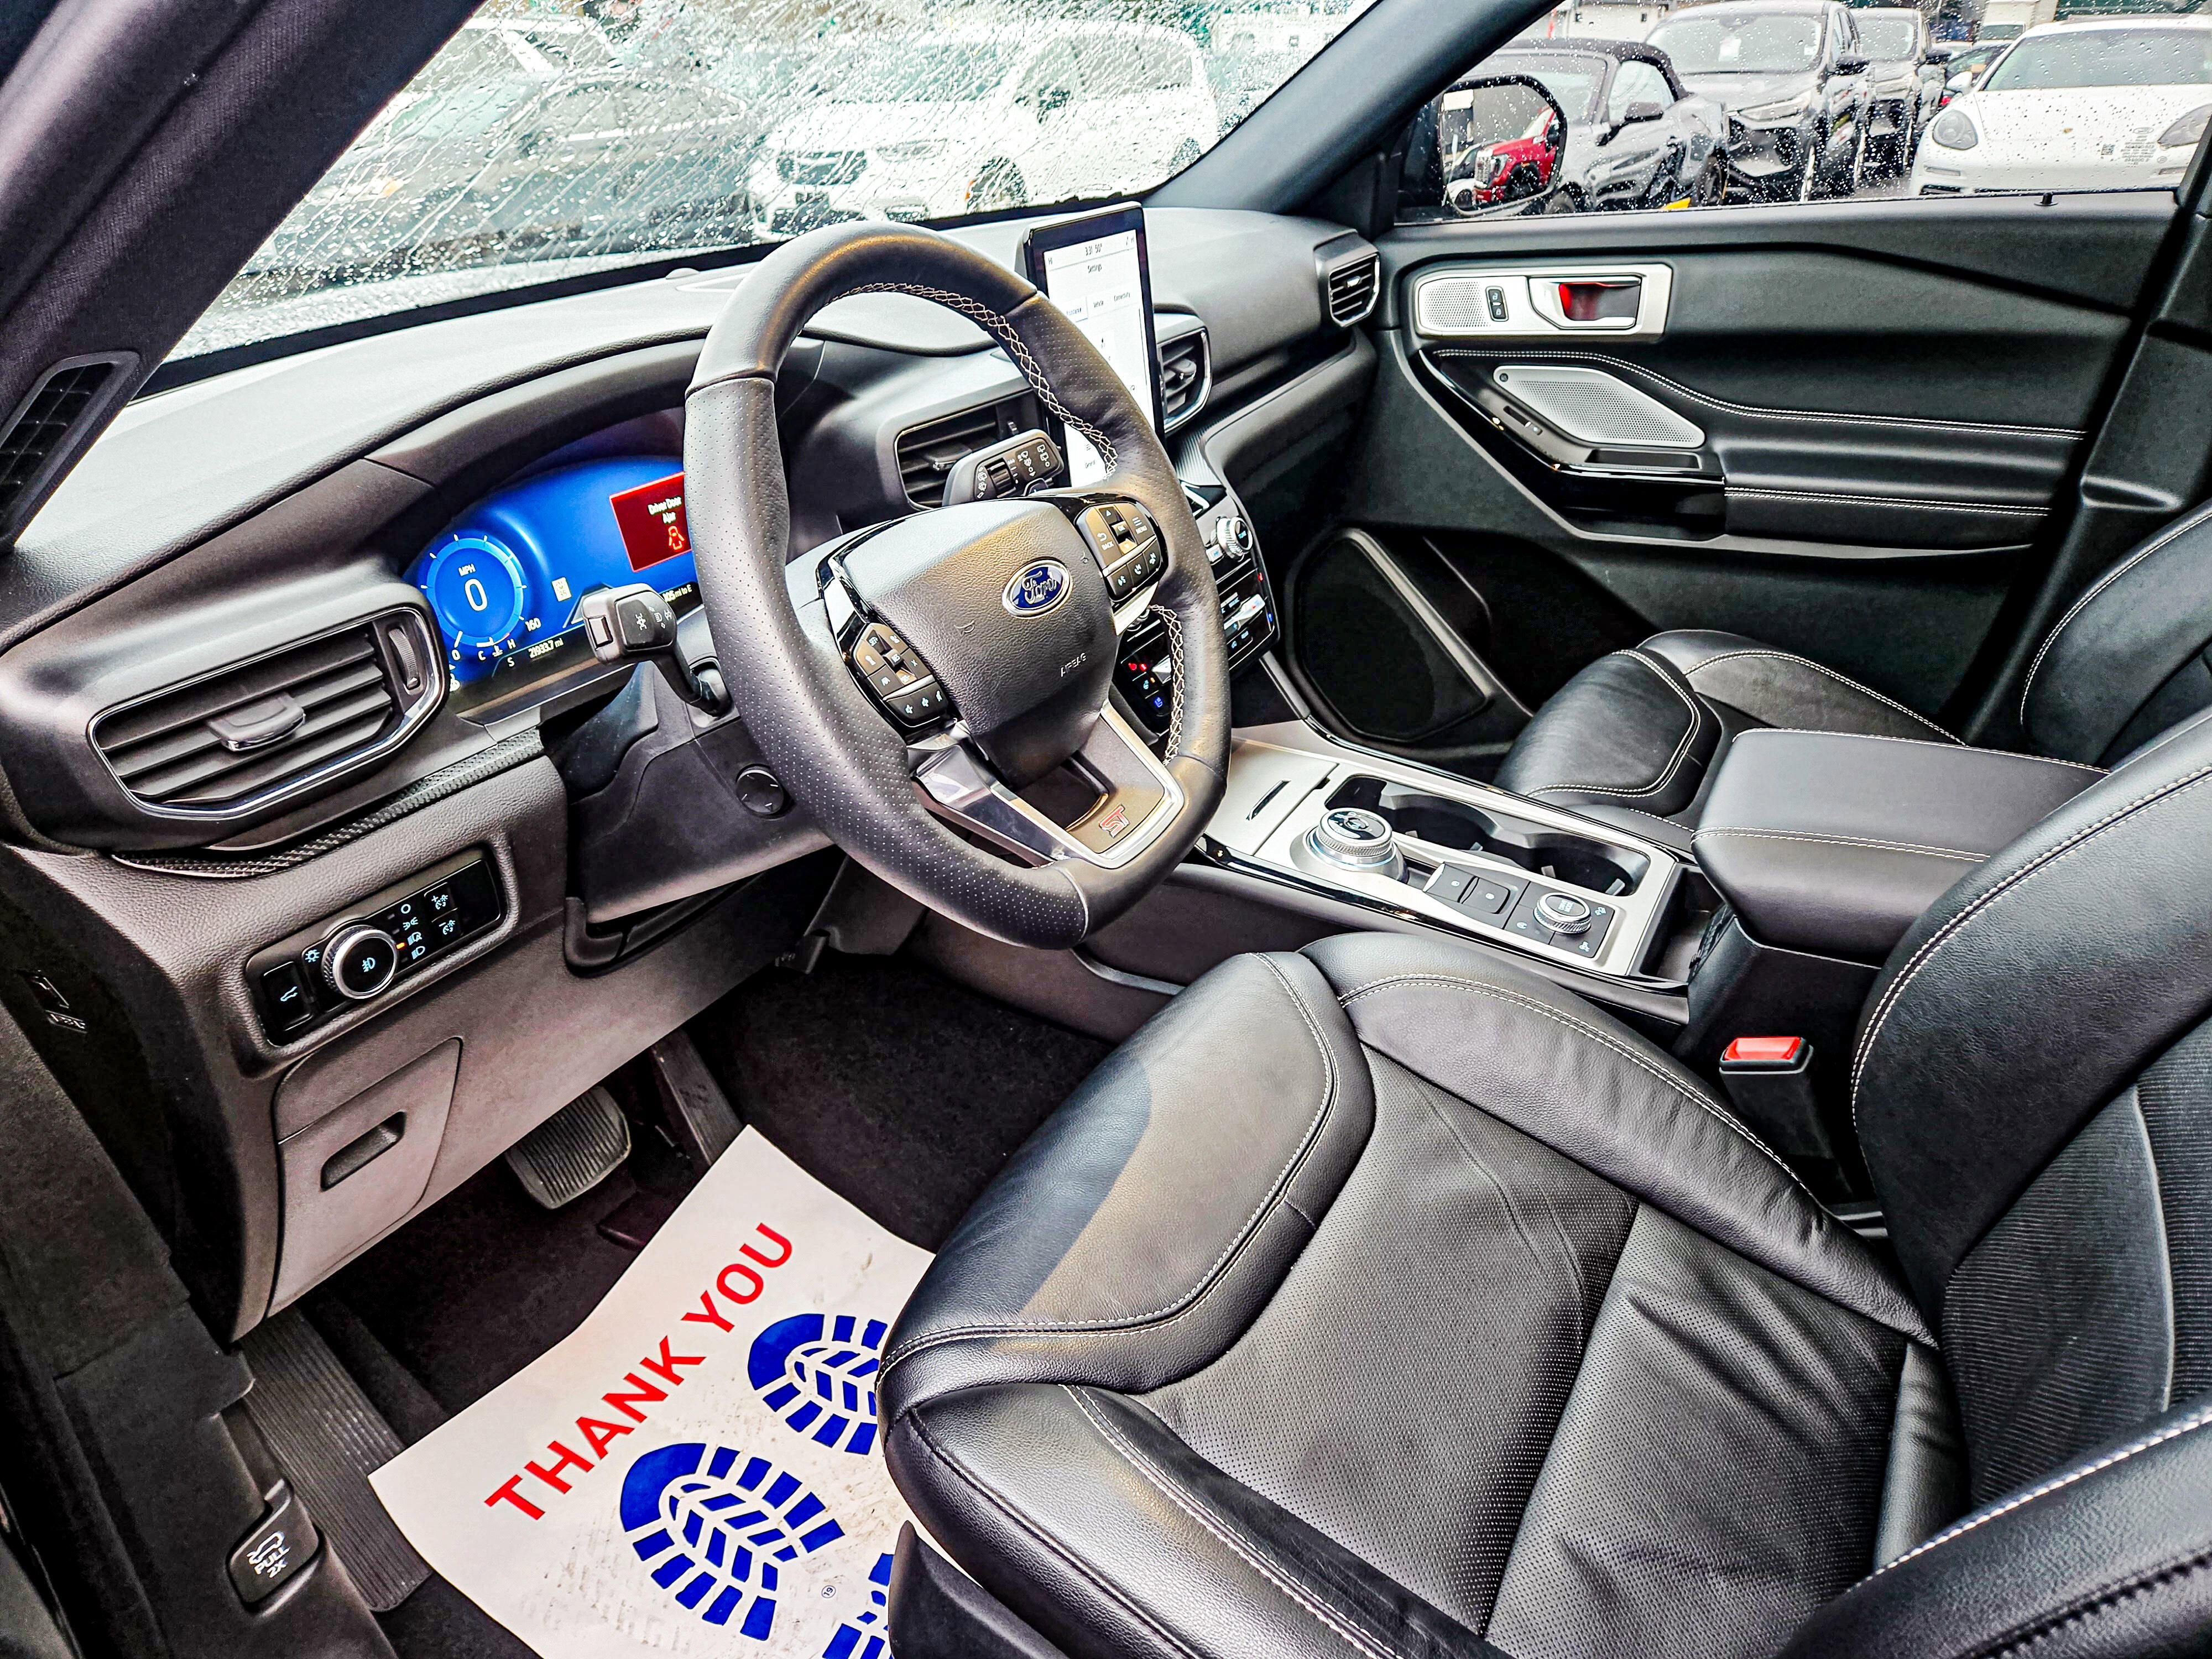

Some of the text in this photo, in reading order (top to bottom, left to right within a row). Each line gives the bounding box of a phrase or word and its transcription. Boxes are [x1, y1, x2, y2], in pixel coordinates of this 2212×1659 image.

[1087, 264, 1102, 274] Settings
[648, 496, 682, 515] Driver Door
[1101, 541, 1114, 551] BACK
[458, 563, 476, 577] MPH
[675, 588, 682, 598] mi
[681, 587, 688, 596] to
[686, 584, 692, 593] E
[1022, 570, 1057, 604] Ford
[465, 578, 488, 612] 0
[525, 618, 541, 632] 160
[507, 638, 517, 649] H
[555, 638, 564, 648] mi
[451, 649, 461, 661] 0
[478, 650, 486, 661] C
[507, 657, 515, 667] S
[1099, 805, 1130, 838] ST
[484, 1223, 792, 1520] THANK YOU
[254, 1546, 291, 1575] PULL
[267, 1558, 288, 1578] 2X
[823, 1587, 833, 1596] 19
